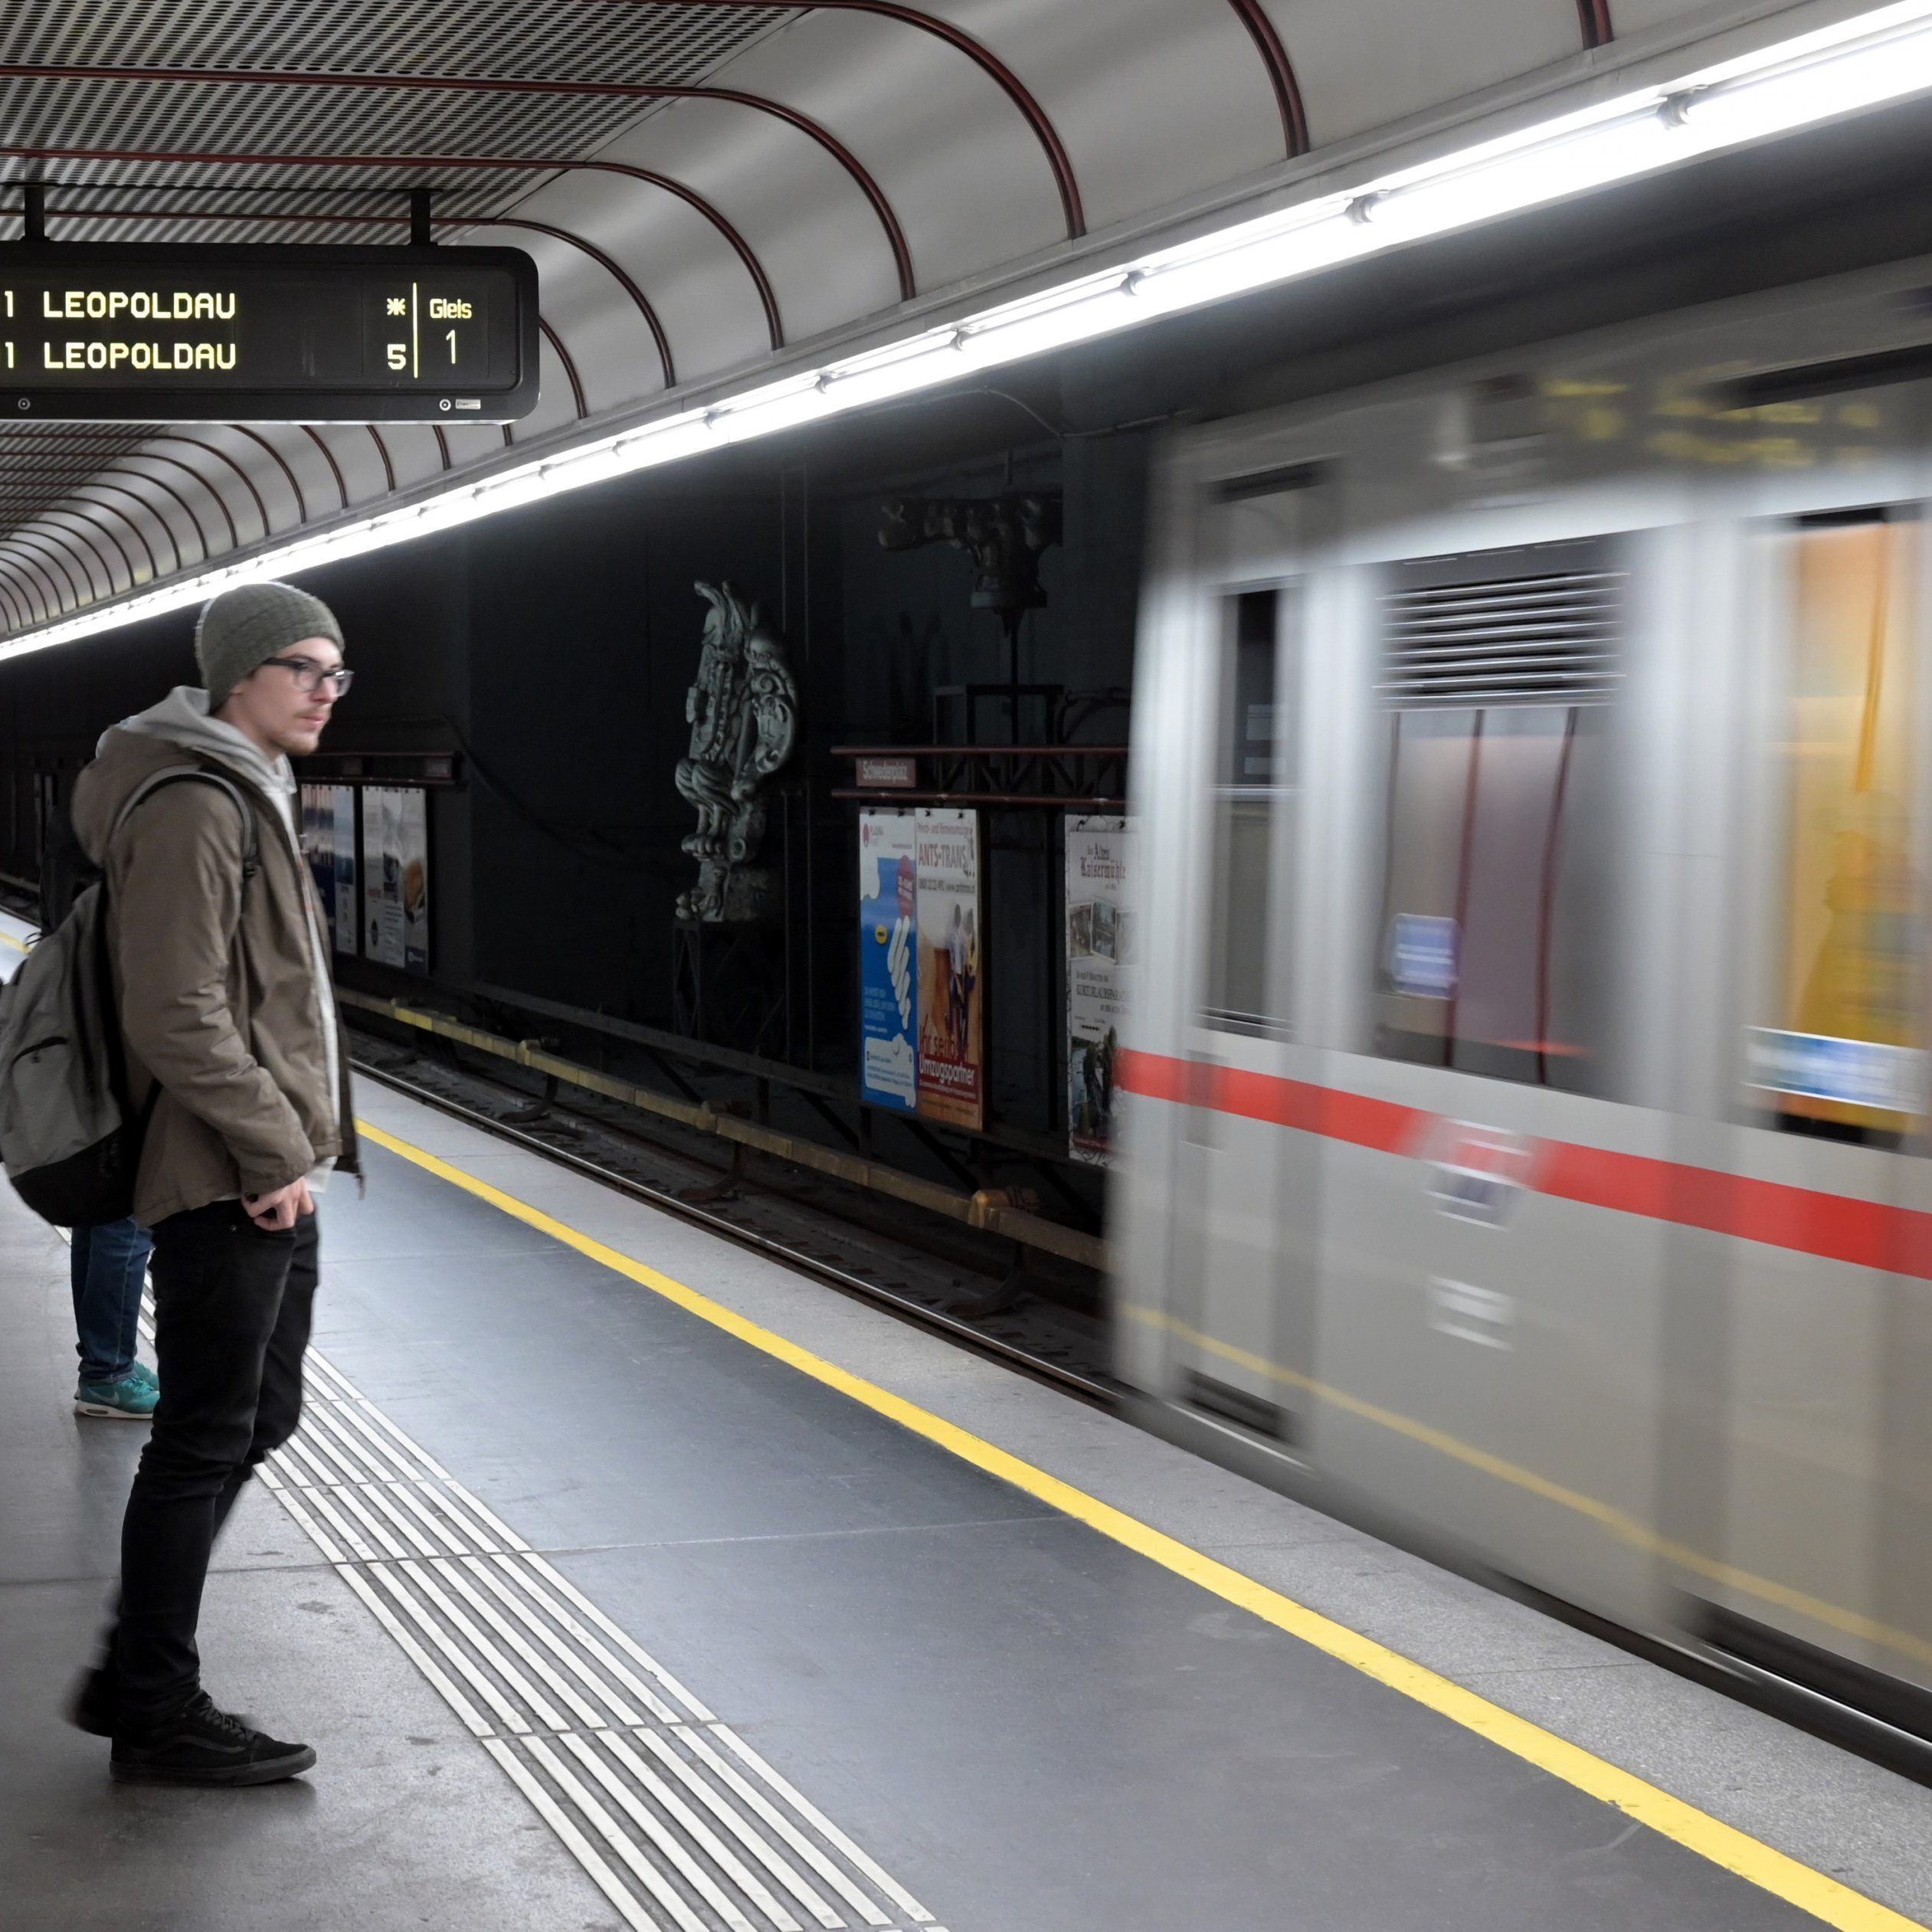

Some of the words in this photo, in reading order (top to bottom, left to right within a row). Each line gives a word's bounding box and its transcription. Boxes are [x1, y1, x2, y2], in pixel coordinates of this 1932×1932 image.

[5, 290, 14, 318] 1
[44, 291, 235, 319] LEOPOLDAU
[430, 298, 473, 319] Gleis
[5, 342, 15, 369] 1
[44, 342, 236, 370] LEOPOLDAU
[387, 344, 407, 370] 5
[446, 329, 456, 365] 1
[919, 1052, 975, 1086] Umzugspartner
